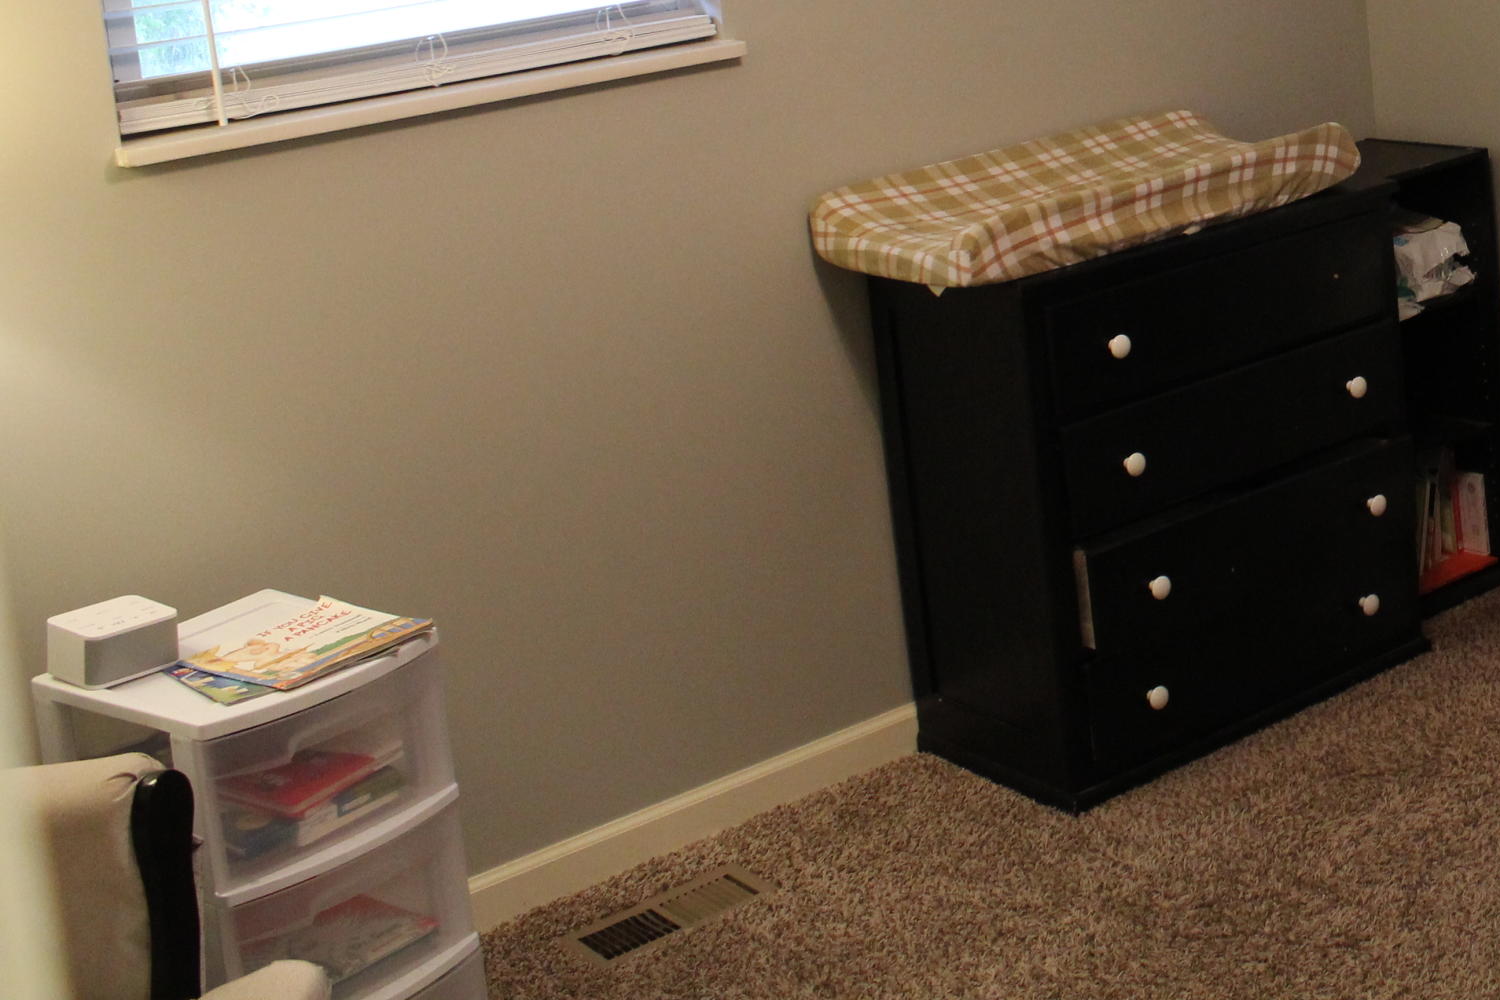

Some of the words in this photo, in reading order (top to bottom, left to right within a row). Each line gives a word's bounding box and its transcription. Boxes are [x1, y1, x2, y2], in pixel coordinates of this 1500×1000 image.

[273, 618, 299, 630] YOU
[300, 601, 333, 619] GIVE
[294, 609, 352, 636] PANCAKE
